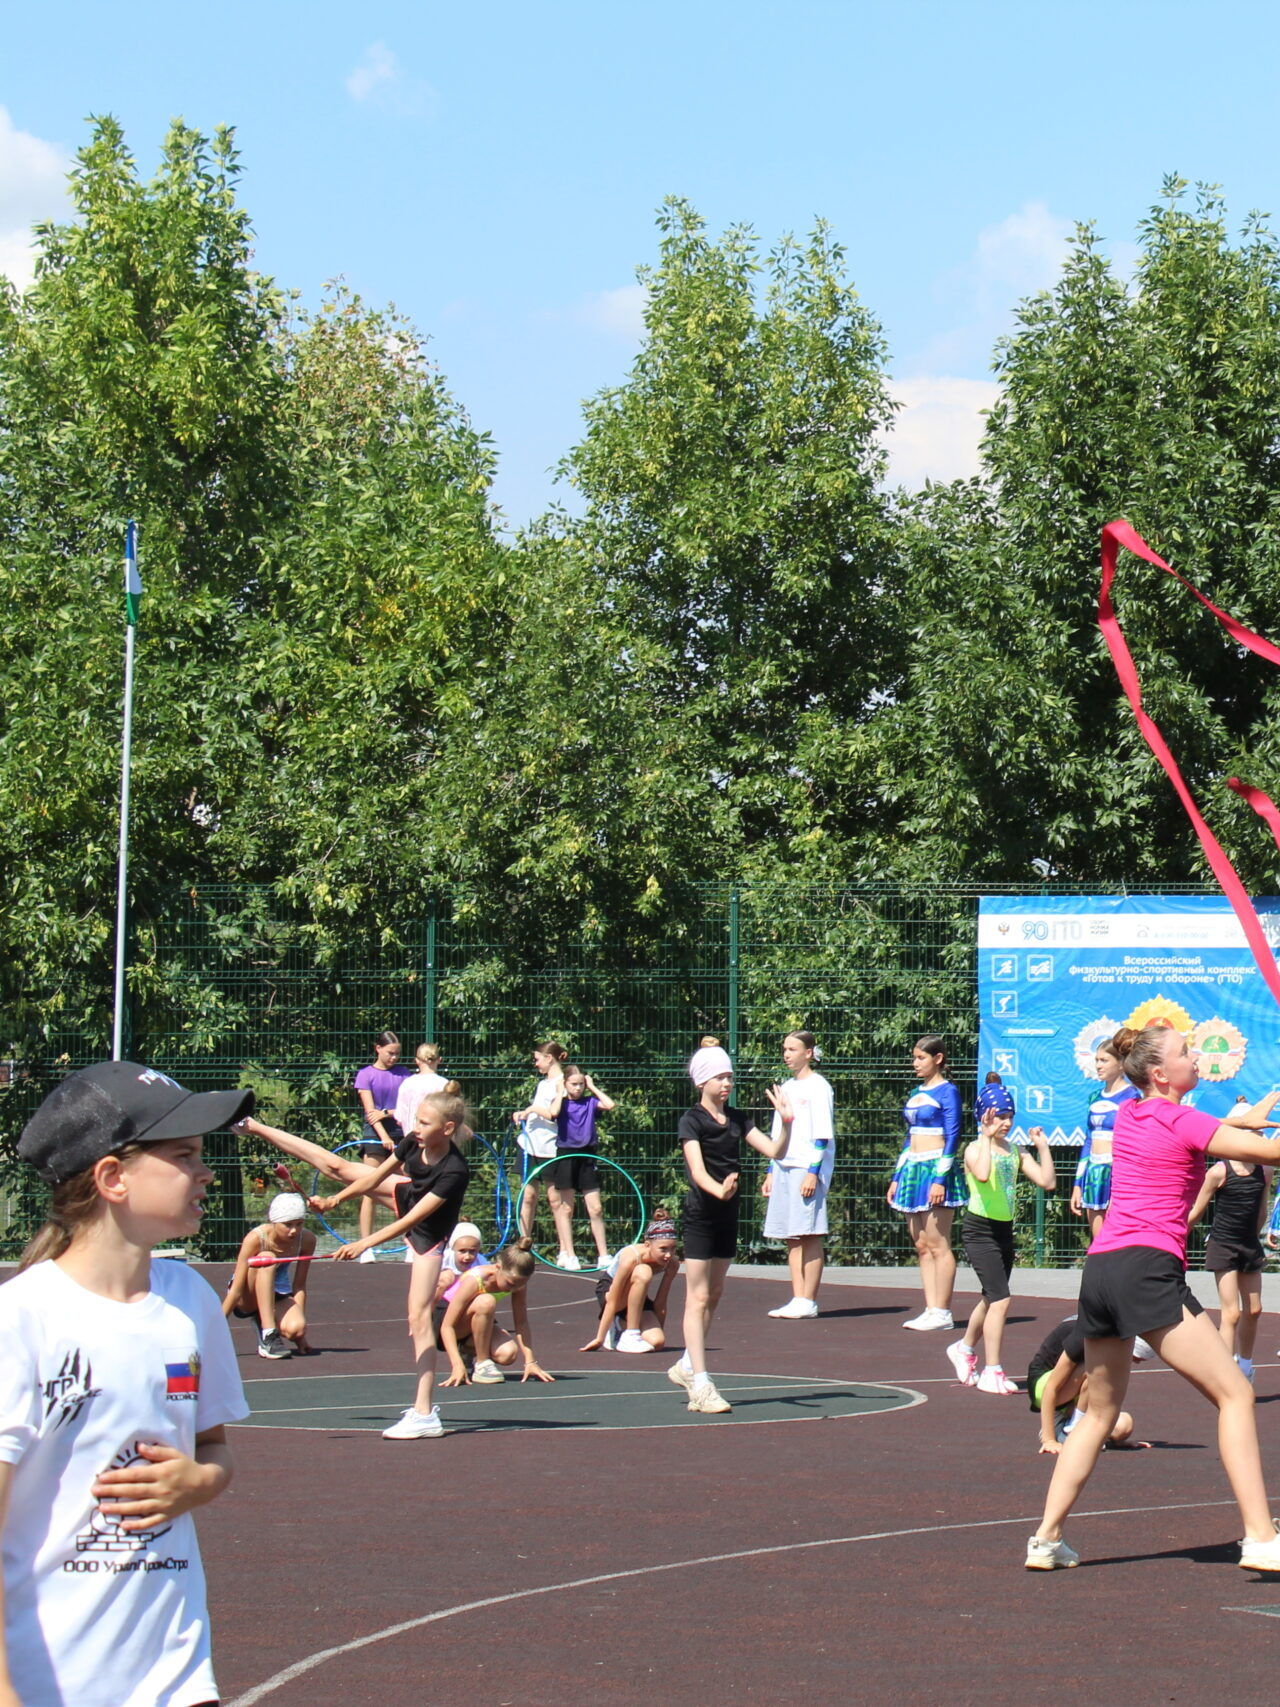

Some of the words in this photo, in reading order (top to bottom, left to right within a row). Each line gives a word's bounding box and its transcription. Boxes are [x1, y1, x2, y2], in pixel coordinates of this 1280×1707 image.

[1022, 920, 1049, 941] 90
[1123, 955, 1202, 966] Всероссийский
[1069, 965, 1205, 976] физкультурно-спортивный
[1207, 966, 1257, 975] комплекс
[1082, 974, 1115, 984] «Готов
[1126, 975, 1152, 985] труду
[1164, 974, 1215, 984] обороне»
[1217, 974, 1243, 985] (ГТО)
[63, 1560, 100, 1573] ООО
